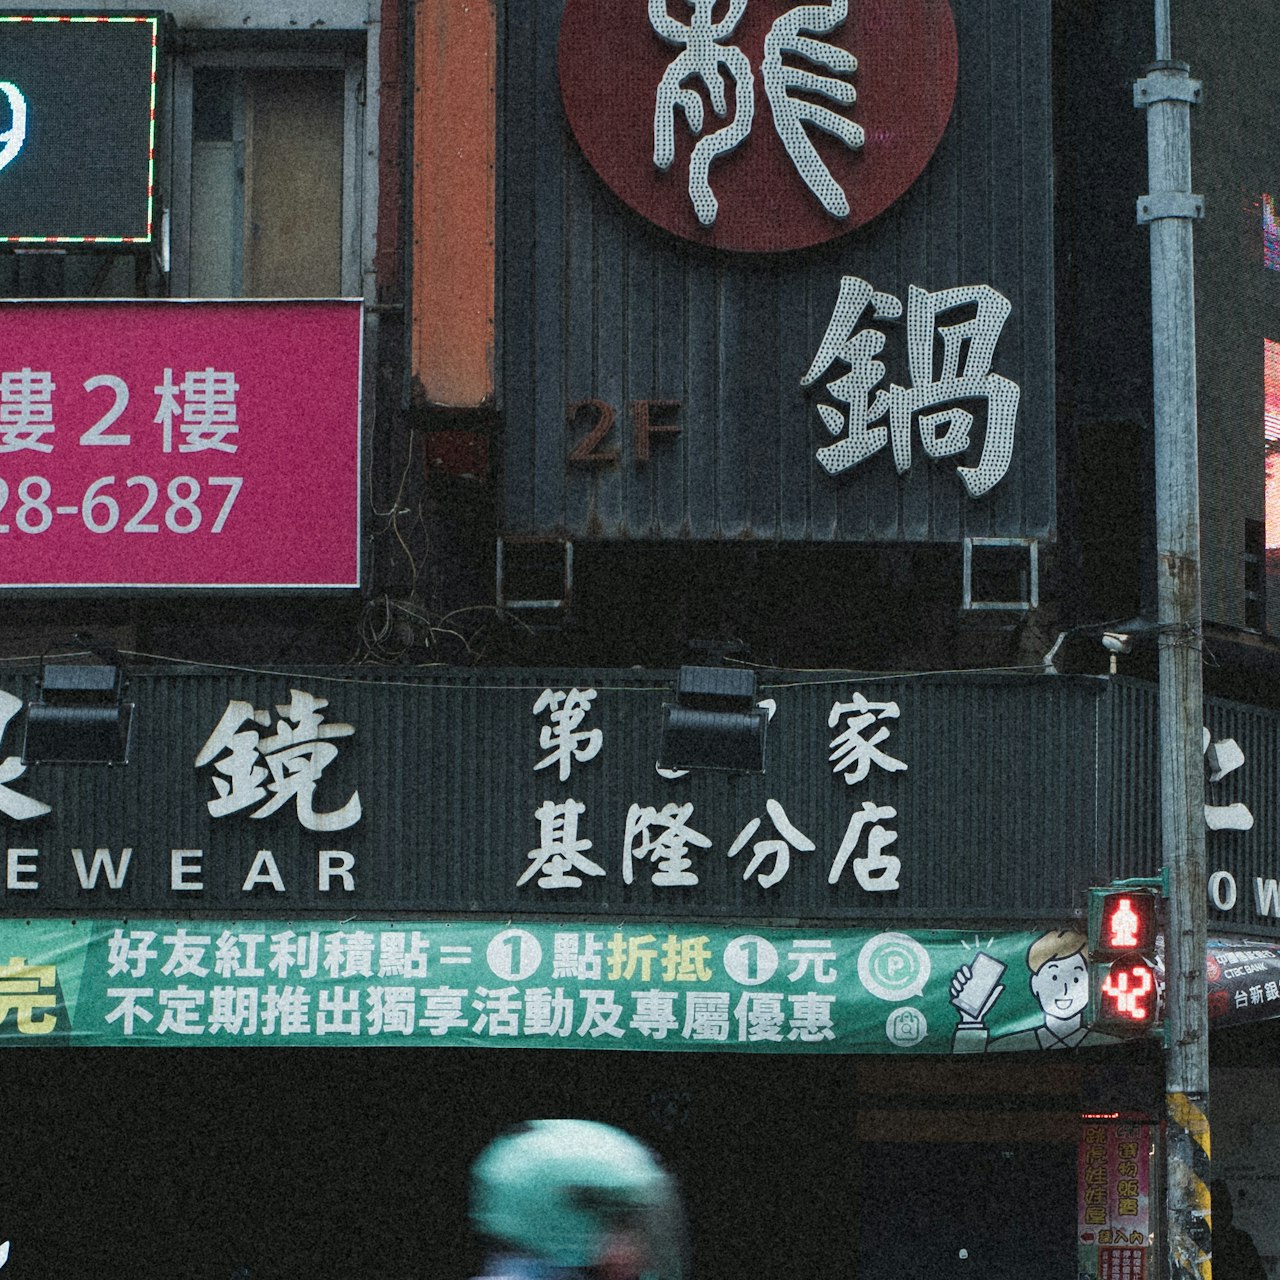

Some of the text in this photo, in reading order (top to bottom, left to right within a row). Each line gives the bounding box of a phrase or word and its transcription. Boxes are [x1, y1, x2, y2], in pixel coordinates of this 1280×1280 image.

[802, 275, 1021, 500] 鍋
[567, 399, 683, 463] 2F
[533, 687, 908, 785] 第家
[516, 798, 901, 893] 基隆分店
[1102, 967, 1152, 1019] 42
[1224, 962, 1268, 979] CTBC BANK
[105, 985, 837, 1042] 不定期推出獨享活動及專屬優惠
